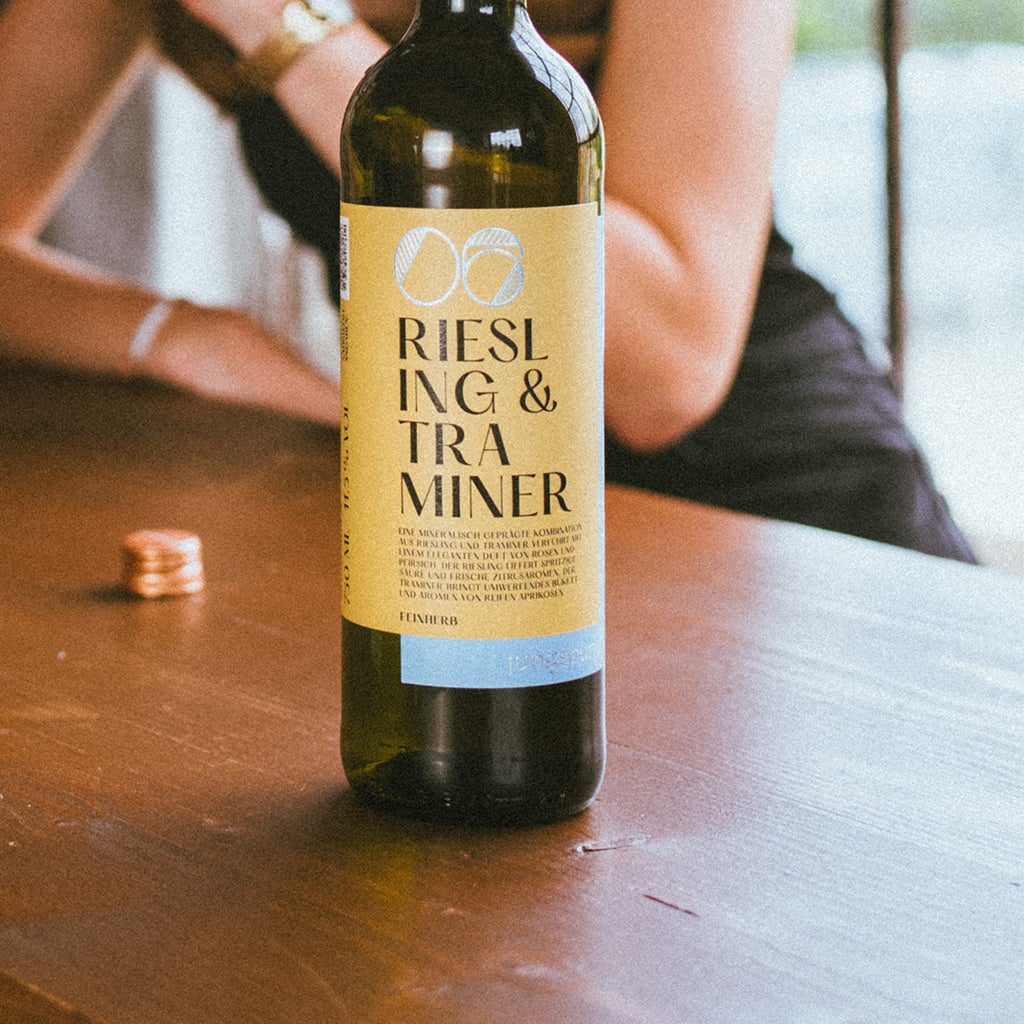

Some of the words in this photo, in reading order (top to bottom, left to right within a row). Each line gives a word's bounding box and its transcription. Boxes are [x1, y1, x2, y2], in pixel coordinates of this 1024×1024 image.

[398, 317, 549, 363] RIESL
[399, 368, 499, 415] ING
[519, 368, 558, 414] &
[398, 420, 511, 466] TRA
[400, 471, 572, 518] MINER
[398, 527, 415, 536] EINE
[418, 529, 481, 540] MINERALISCH
[533, 523, 583, 537] KOMBINATION
[399, 537, 415, 546] AUS
[416, 539, 457, 549] RIESLING
[459, 542, 480, 550] UND
[483, 540, 529, 550] TRAMINER
[398, 547, 424, 557] EINEM
[509, 550, 529, 560] VON
[531, 548, 559, 558] ROSEN
[560, 545, 575, 555] UND
[441, 562, 459, 570] DER
[462, 562, 503, 571] RIESLING
[428, 571, 447, 580] UND
[449, 572, 490, 581] FRISCHE
[400, 579, 443, 590] TRAMINER
[446, 583, 481, 591] BRINGT
[398, 589, 417, 598] UND
[419, 591, 458, 601] AROMEN
[460, 593, 482, 602] VON
[399, 611, 458, 626] FEINHERB
